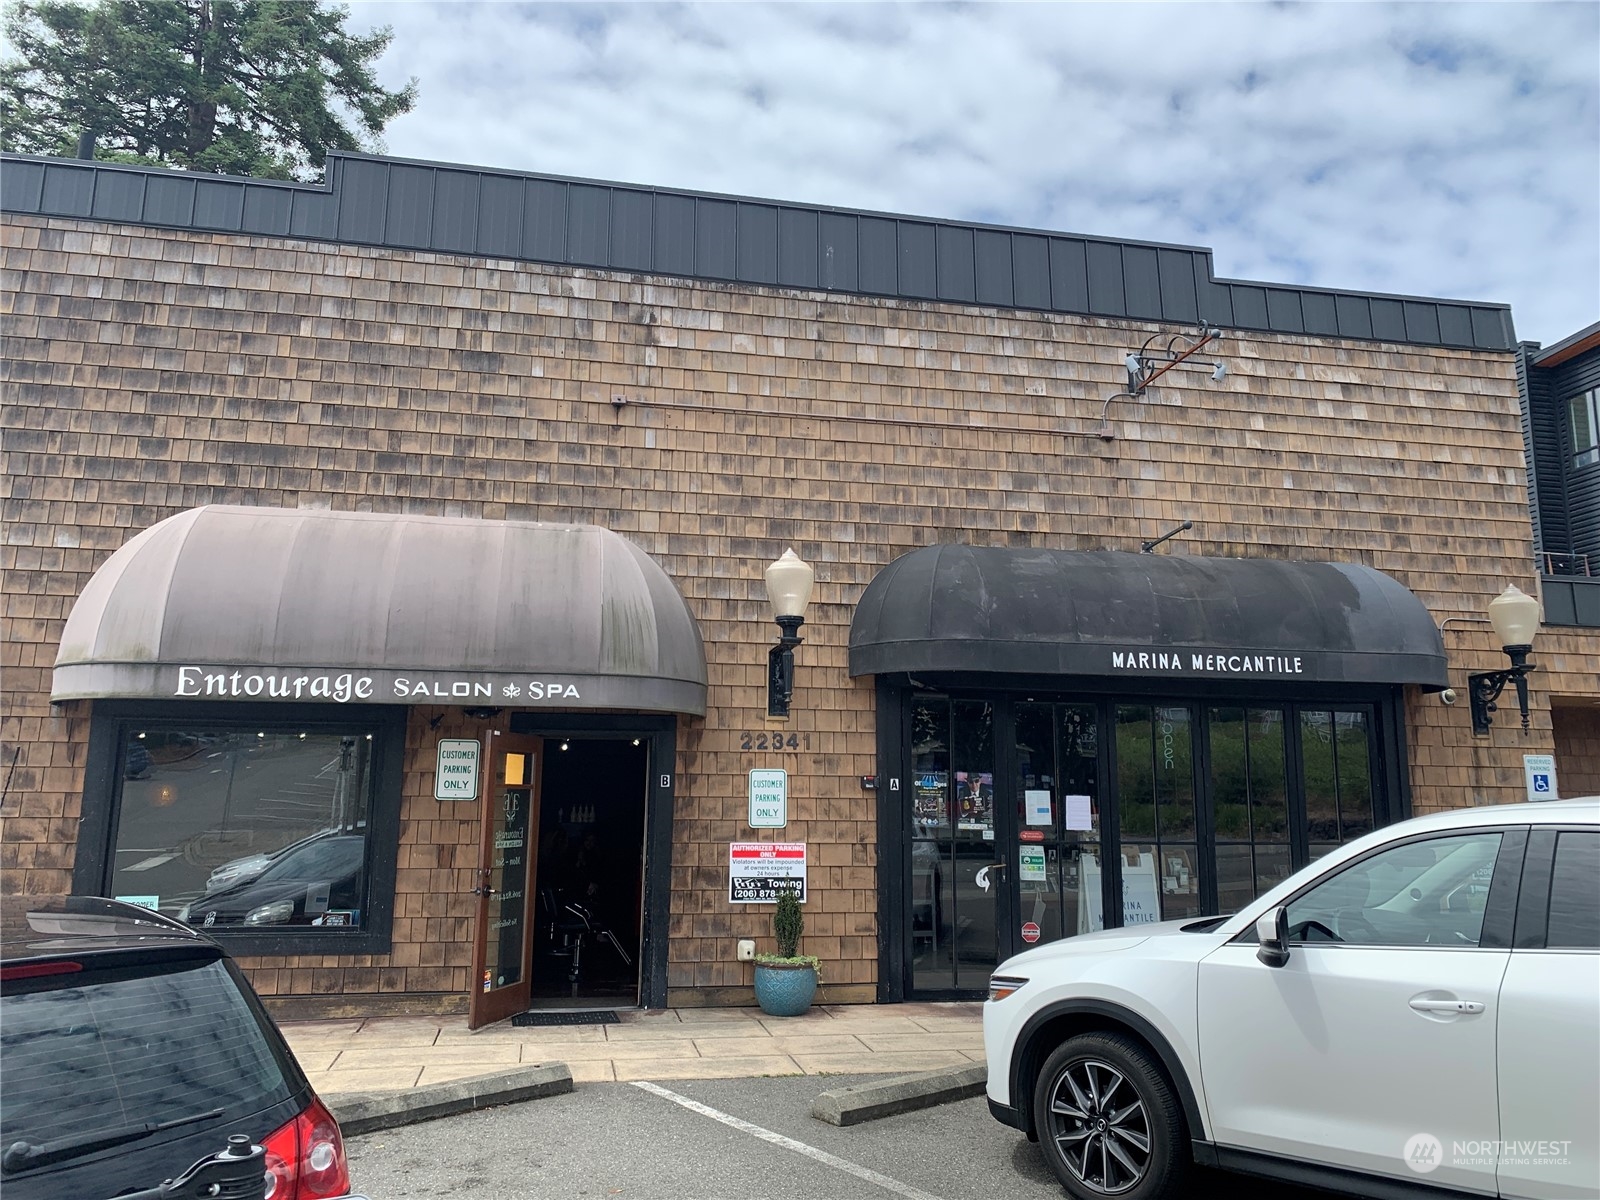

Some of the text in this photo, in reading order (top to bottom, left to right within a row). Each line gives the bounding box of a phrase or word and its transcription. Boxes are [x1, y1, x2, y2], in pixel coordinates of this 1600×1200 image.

[1112, 651, 1303, 673] MARINA MERCANTILE
[173, 666, 581, 703] Entourage SALON SPA
[740, 732, 811, 751] 22341
[441, 750, 475, 760] CUSTOMER
[443, 765, 472, 774] PARKING
[444, 780, 469, 789] ONLY
[662, 775, 669, 786] B
[753, 780, 783, 789] CUSTOMER
[891, 779, 898, 790] A
[755, 794, 781, 802] PARKING
[756, 808, 779, 817] ONLY
[767, 879, 803, 890] Towing
[734, 889, 757, 899] (206)
